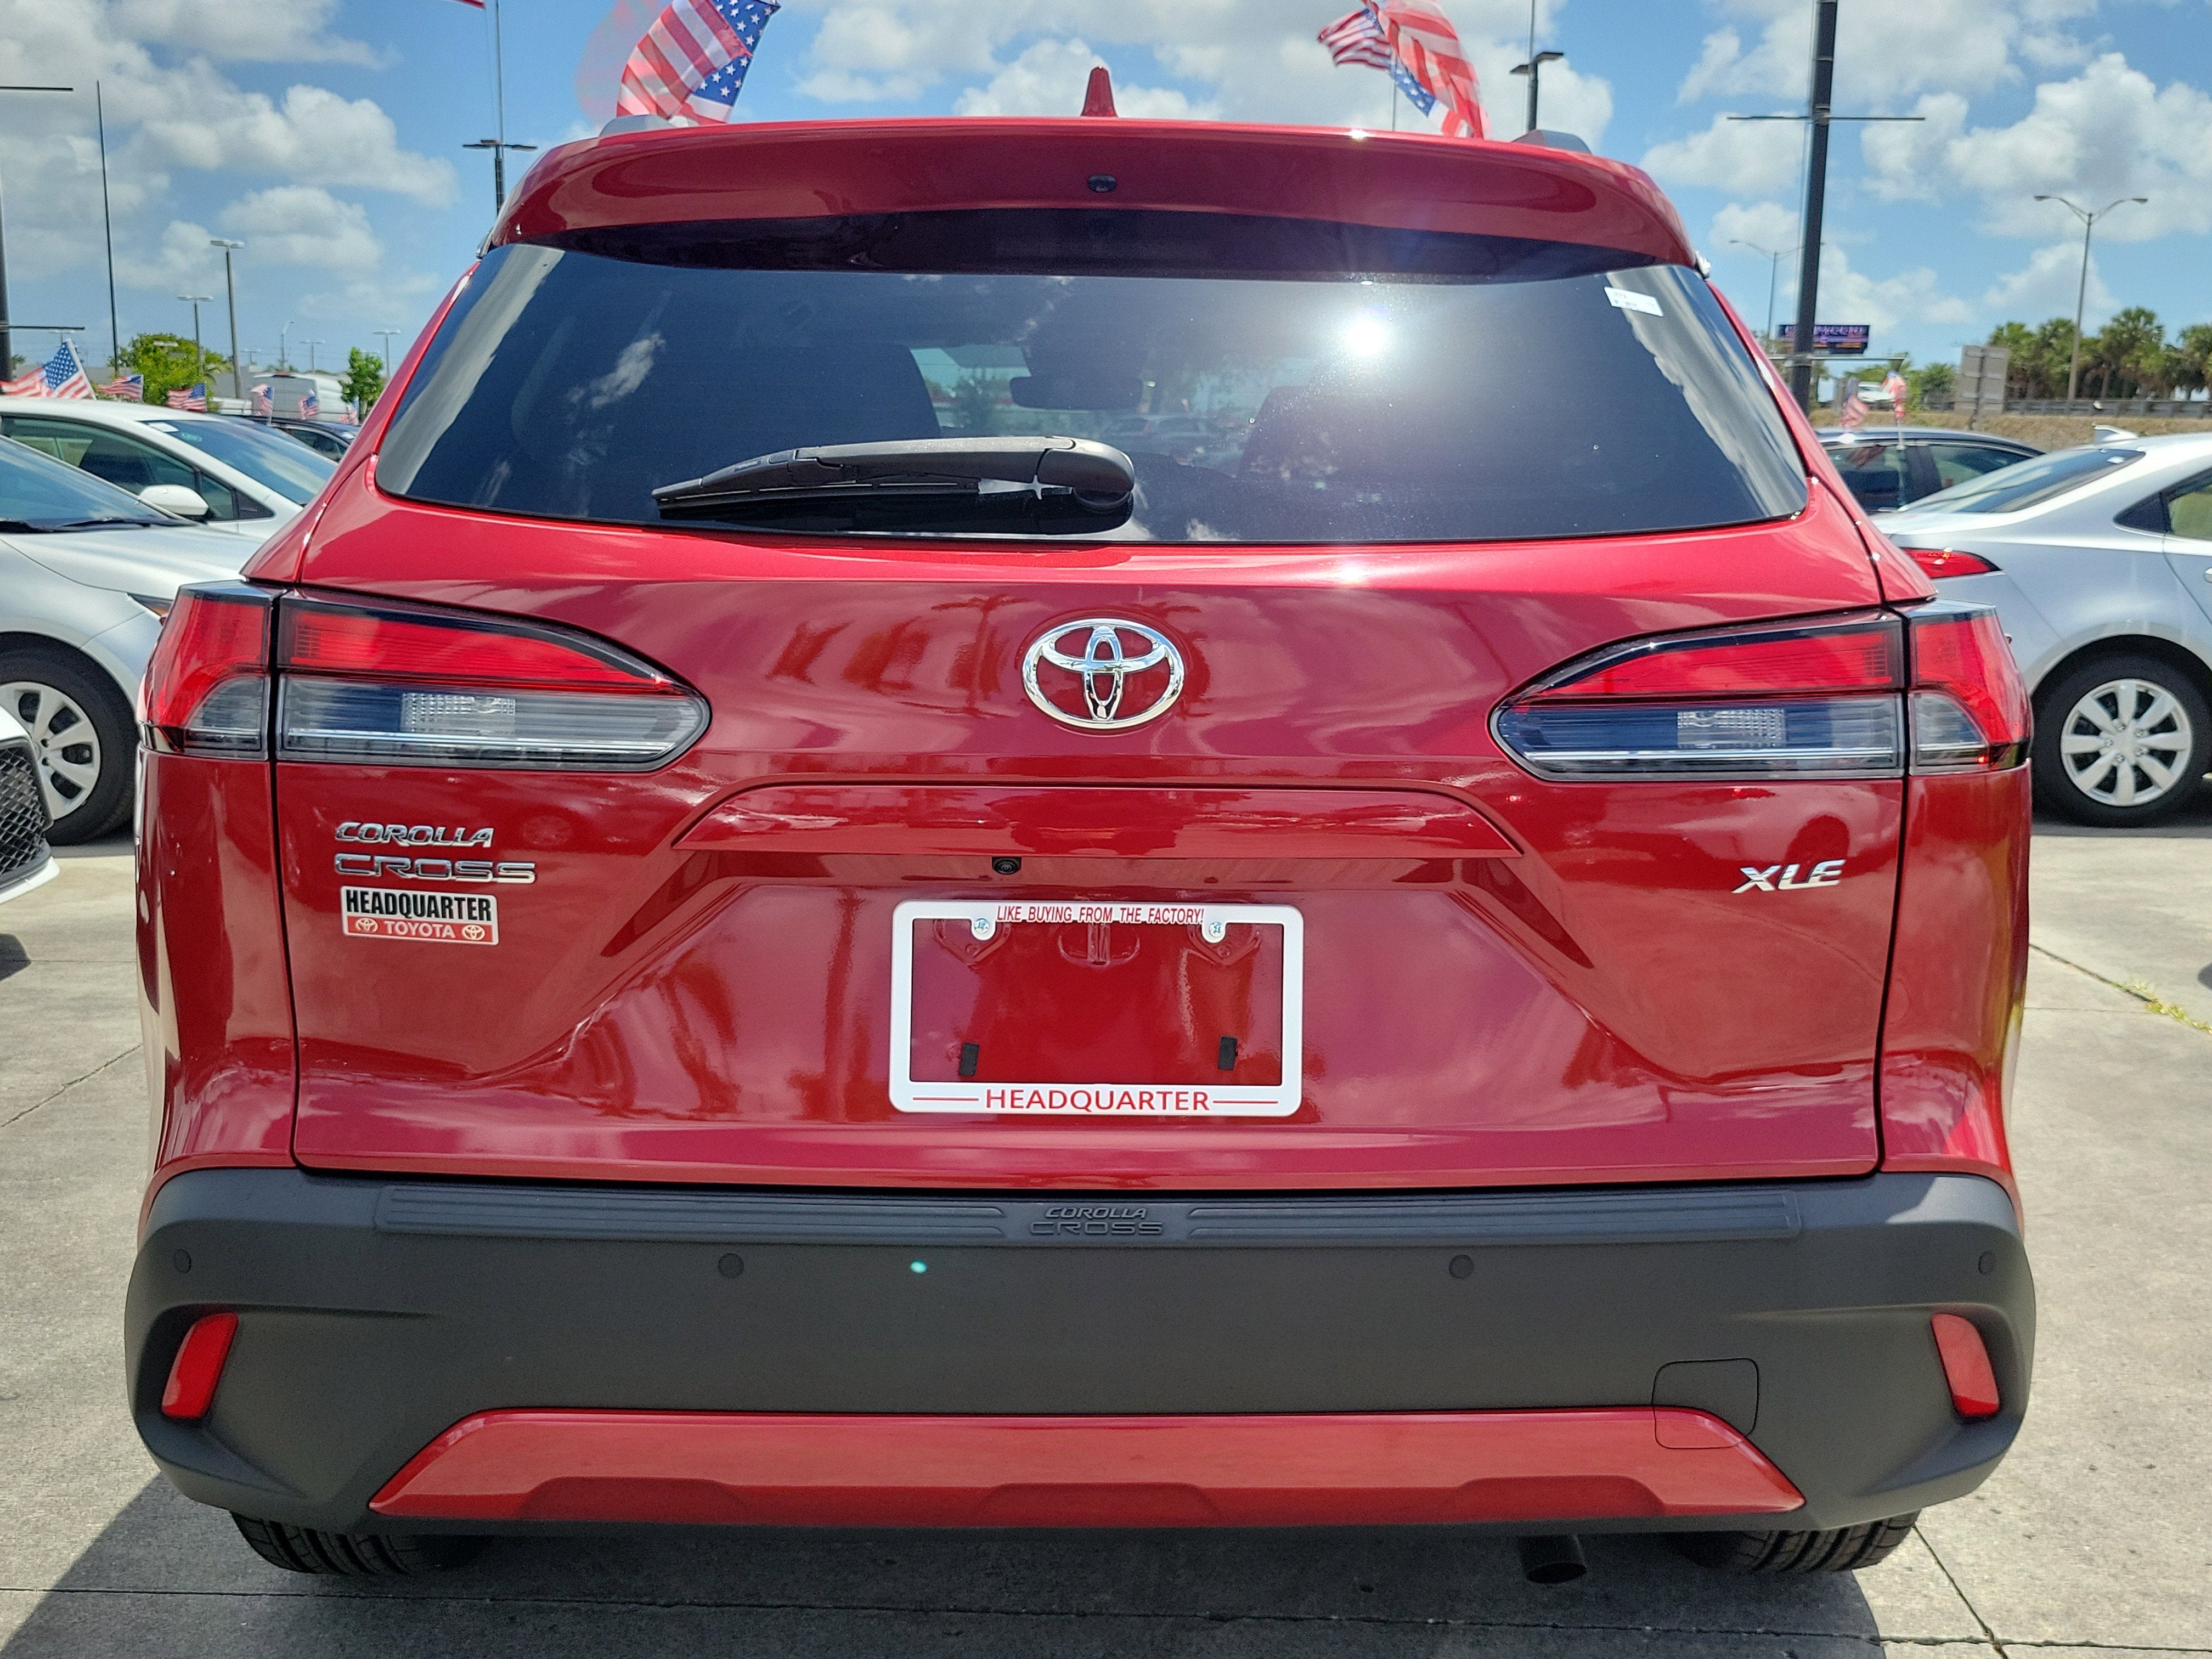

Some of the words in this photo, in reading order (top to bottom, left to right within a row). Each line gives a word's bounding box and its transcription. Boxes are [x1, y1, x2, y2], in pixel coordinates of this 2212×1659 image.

[335, 822, 494, 848] COROLLA
[335, 853, 535, 883] CROSS
[1731, 859, 1846, 893] XLE
[346, 890, 492, 922] HEADQUARTER
[997, 906, 1022, 921] LIKE
[1028, 906, 1072, 921] BUYING
[1079, 907, 1113, 922] FROM
[1120, 908, 1142, 922] THE
[1148, 908, 1204, 923] FACTORY!
[385, 921, 455, 938] TOYOTA
[985, 1088, 1210, 1111] HEADQUARTER
[1045, 1207, 1147, 1219] COROLLA
[1030, 1222, 1163, 1235] CROSS
